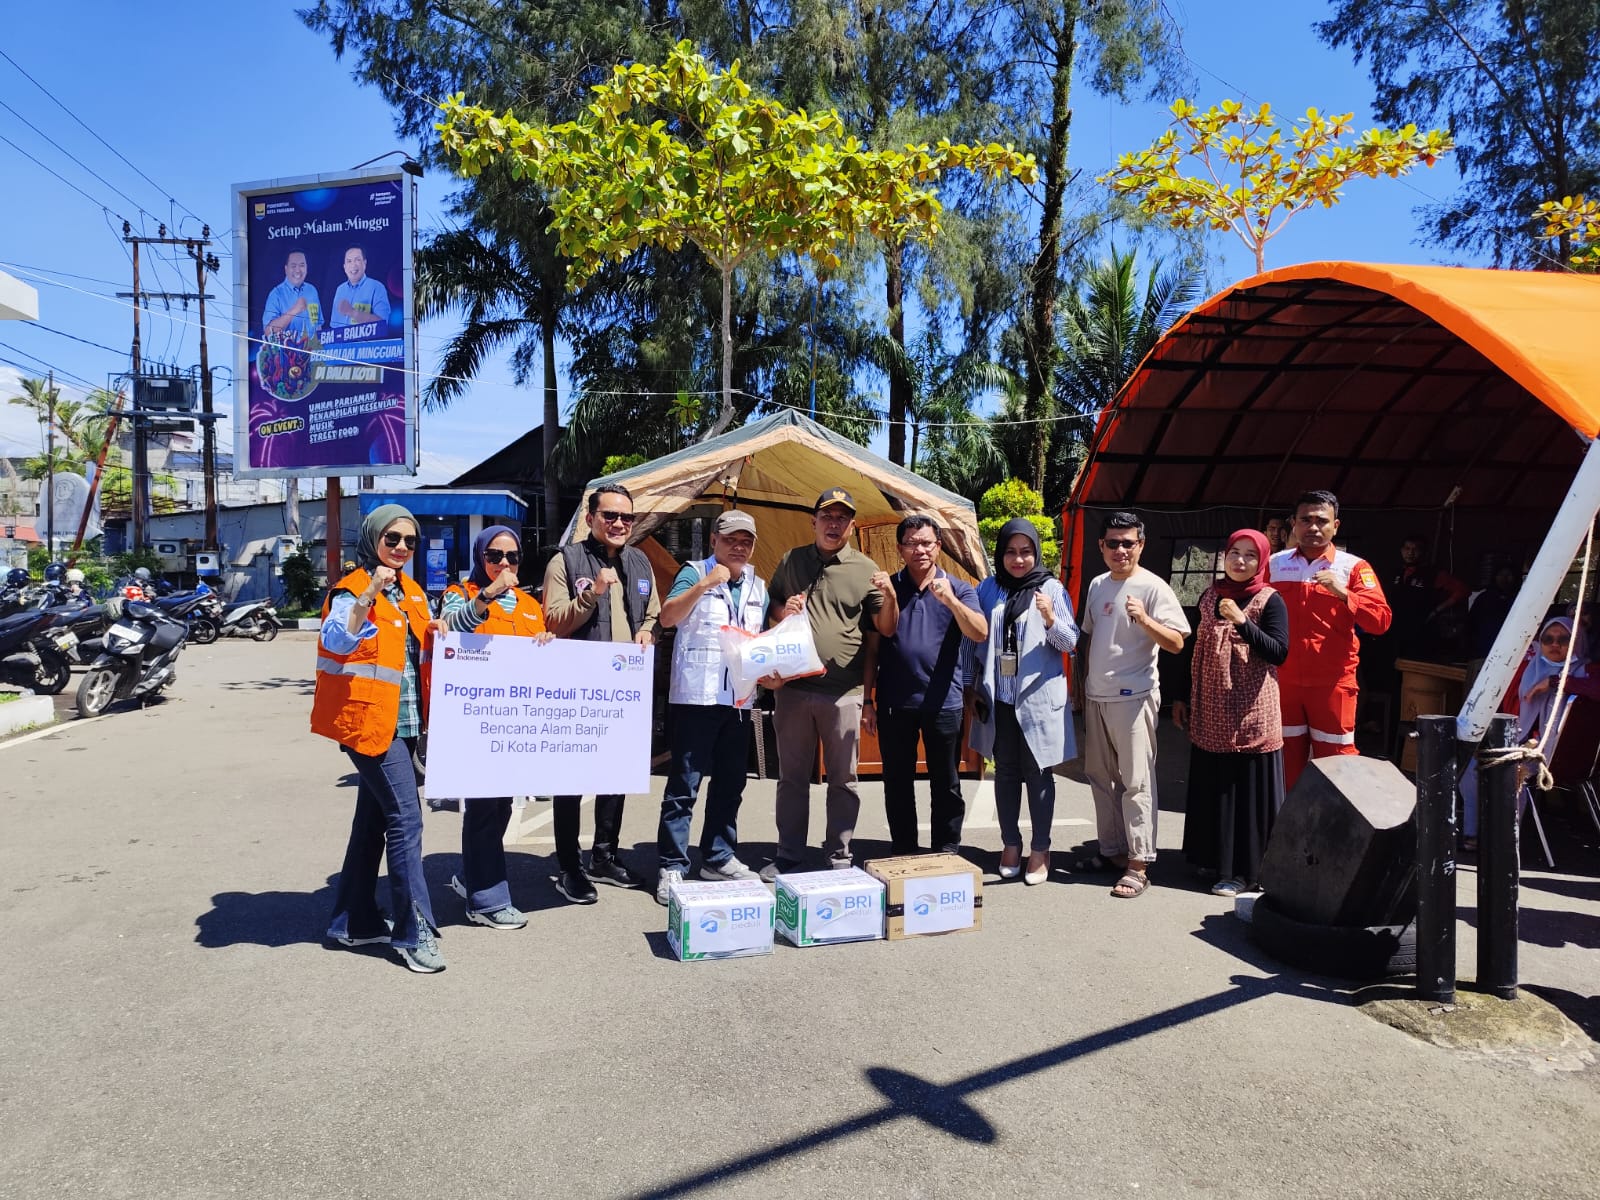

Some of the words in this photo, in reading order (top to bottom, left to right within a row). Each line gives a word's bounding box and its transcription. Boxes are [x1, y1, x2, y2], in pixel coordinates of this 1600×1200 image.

[267, 226, 301, 240] Setiap
[303, 219, 343, 235] Malam
[344, 215, 390, 232] Minggu
[320, 330, 335, 344] BM
[343, 323, 378, 340] BALKOT
[356, 345, 404, 359] MINGGUAN
[315, 366, 326, 380] DI
[325, 366, 352, 380] BALAI
[351, 366, 377, 380] KOTA
[309, 401, 334, 413] UMKM
[334, 392, 377, 409] PARIAMAN
[309, 405, 359, 423] PENAMPILAN
[359, 398, 399, 413] KESENIAN
[260, 424, 272, 435] ON
[273, 419, 298, 433] EVENT
[309, 420, 335, 434] MUSIK
[309, 430, 337, 444] STREET
[338, 426, 360, 439] FOOD
[457, 647, 492, 656] Danantara
[775, 643, 801, 655] BRI
[456, 654, 489, 662] Indonesia
[628, 655, 645, 665] BRI
[444, 683, 505, 700] Program
[509, 686, 532, 699] BRI
[535, 687, 577, 700] Peduli
[580, 688, 641, 702] TJSL/CSR
[463, 702, 518, 717] Bantuan
[522, 704, 577, 721] Tanggap
[580, 706, 624, 719] Darurat
[480, 721, 537, 735] Bencana
[540, 722, 572, 735] Alam
[575, 723, 609, 738] Banjir
[490, 740, 504, 753] Di
[507, 740, 537, 753] Kota
[540, 740, 598, 753] Pariaman
[844, 895, 872, 909] BRI
[940, 890, 966, 905] BRI
[731, 906, 761, 922] BRI
